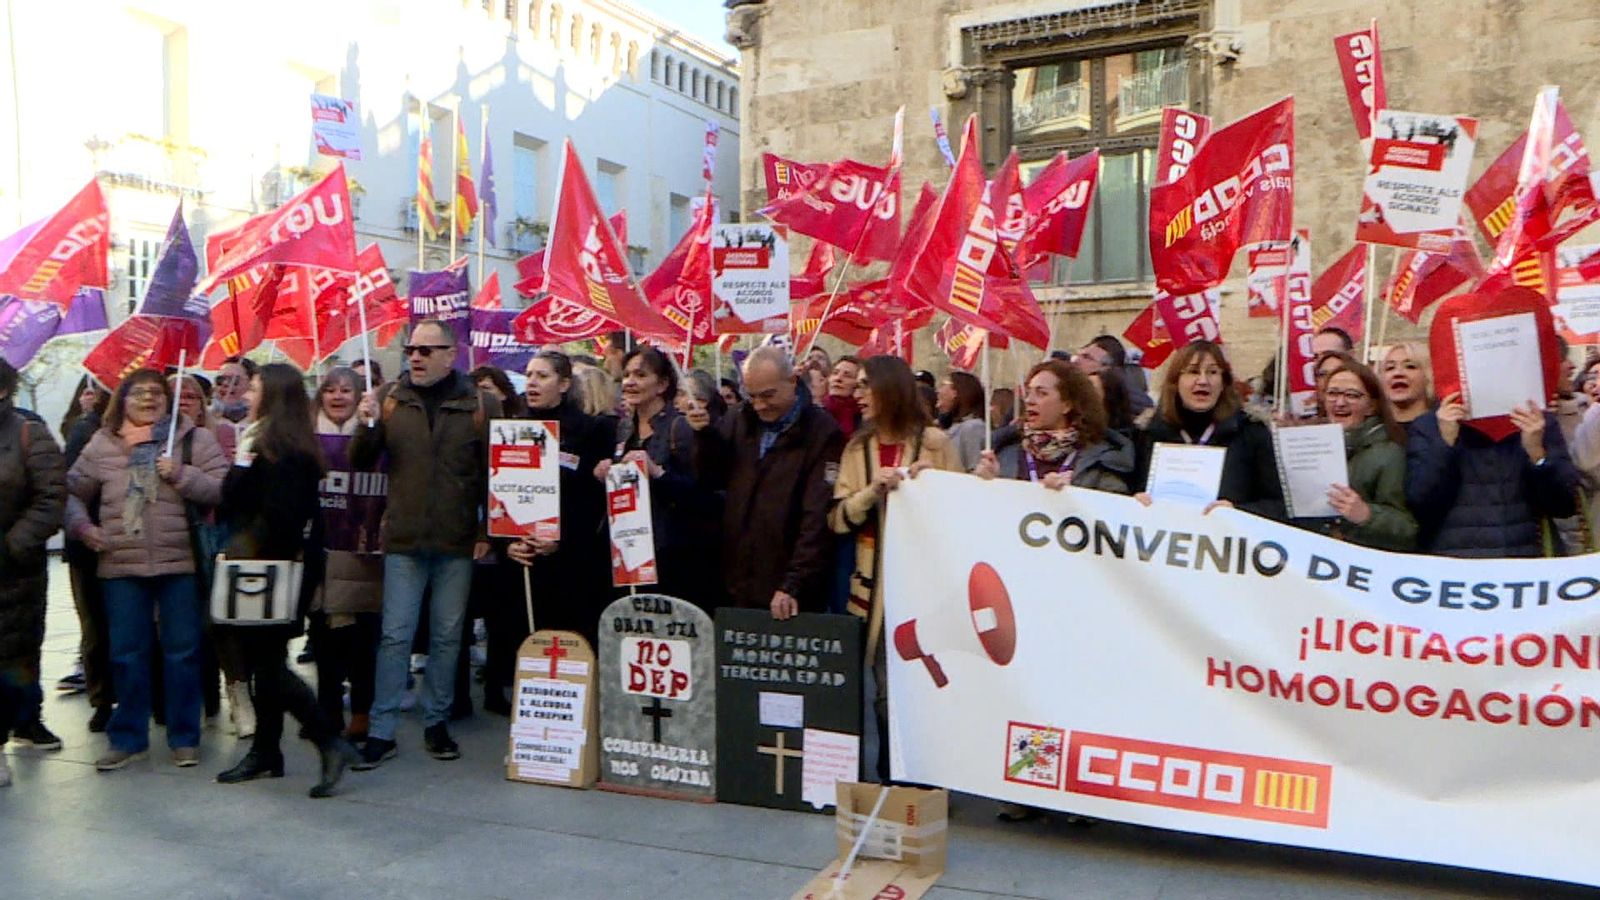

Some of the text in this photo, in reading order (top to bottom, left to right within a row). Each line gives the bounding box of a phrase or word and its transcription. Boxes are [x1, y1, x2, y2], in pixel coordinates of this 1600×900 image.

[1018, 511, 1289, 578] CONVENIO
[1306, 554, 1373, 592] DE
[723, 629, 842, 655] RESIDENCIA
[720, 664, 792, 683] TERCERA
[732, 648, 819, 669] MONCADA
[628, 662, 689, 698] DEP
[1077, 744, 1245, 805] CCOO
